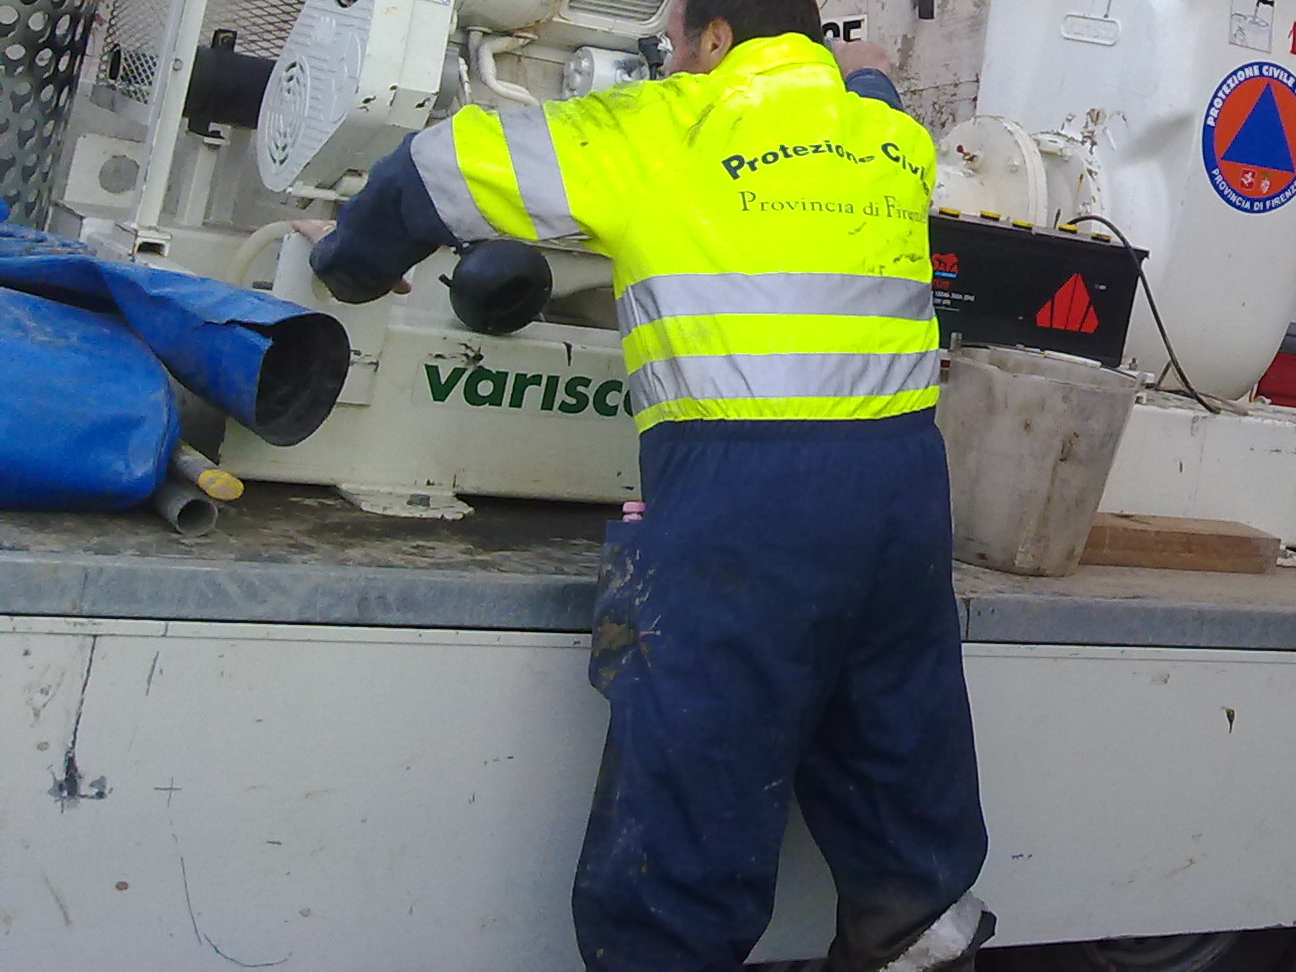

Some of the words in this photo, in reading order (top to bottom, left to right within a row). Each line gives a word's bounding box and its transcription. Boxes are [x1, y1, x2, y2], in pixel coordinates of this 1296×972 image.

[1206, 65, 1260, 127] PROTEZIONE
[1262, 65, 1296, 86] CIVILE
[738, 191, 854, 214] Provincia
[862, 200, 880, 217] di
[1211, 168, 1251, 210] PROVINCIA
[1254, 201, 1263, 210] DI
[424, 363, 634, 418] varisc
